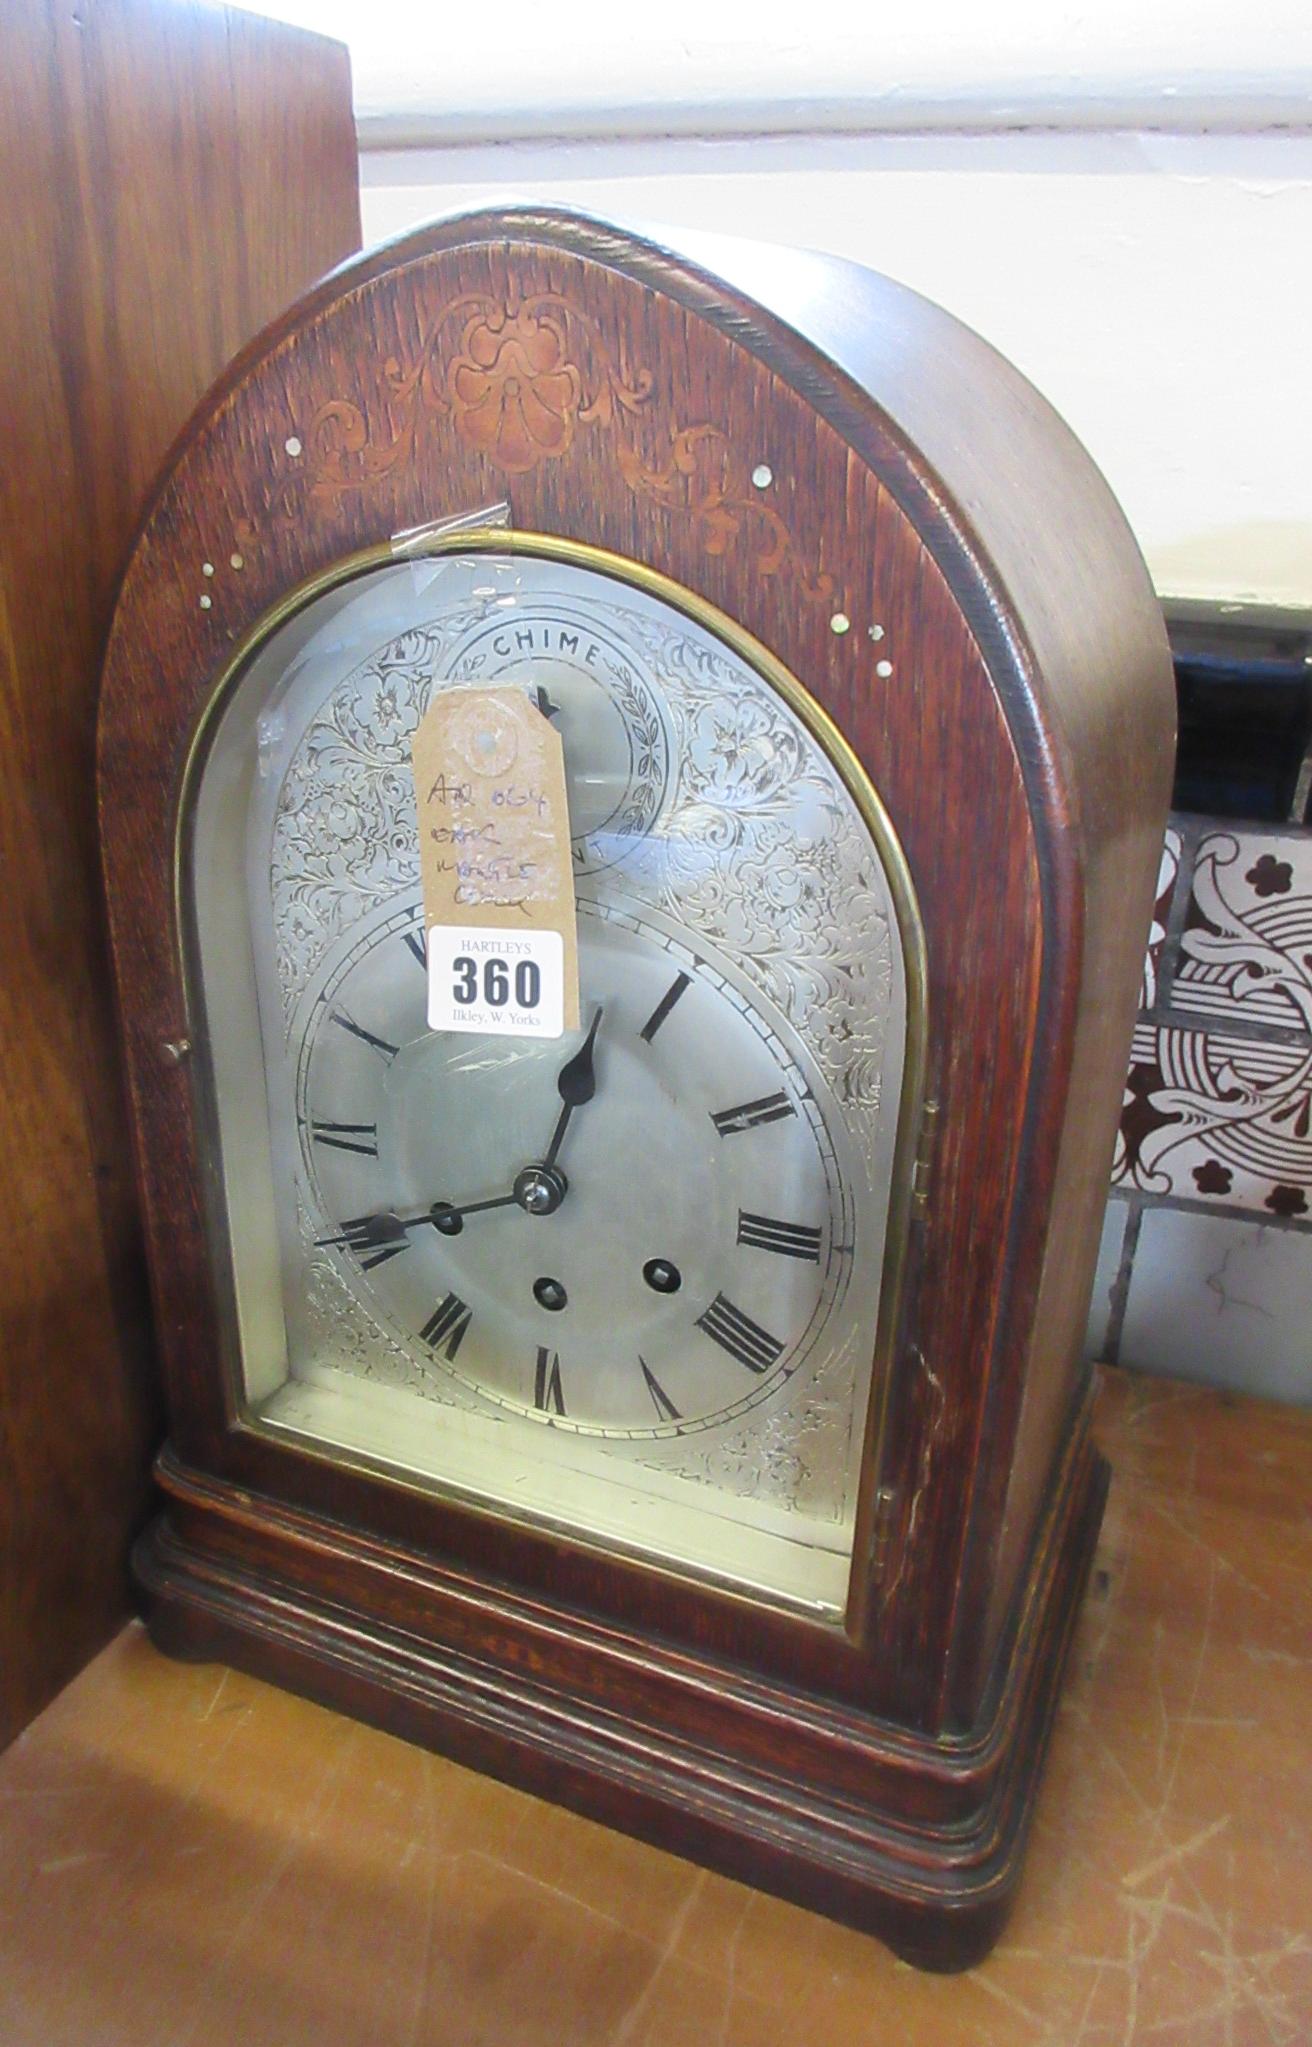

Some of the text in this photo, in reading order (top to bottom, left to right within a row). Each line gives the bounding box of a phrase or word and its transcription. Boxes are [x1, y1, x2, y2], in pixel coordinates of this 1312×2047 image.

[493, 629, 601, 667] CHIME
[461, 939, 533, 955] HARTLEYS
[452, 956, 541, 1009] 360
[636, 968, 695, 1045] I
[490, 1010, 507, 1025] W.
[508, 1012, 541, 1026] Yorks
[708, 1086, 798, 1138] II
[736, 1207, 822, 1265] III
[693, 1290, 787, 1375] IIII
[638, 1353, 684, 1421] V
